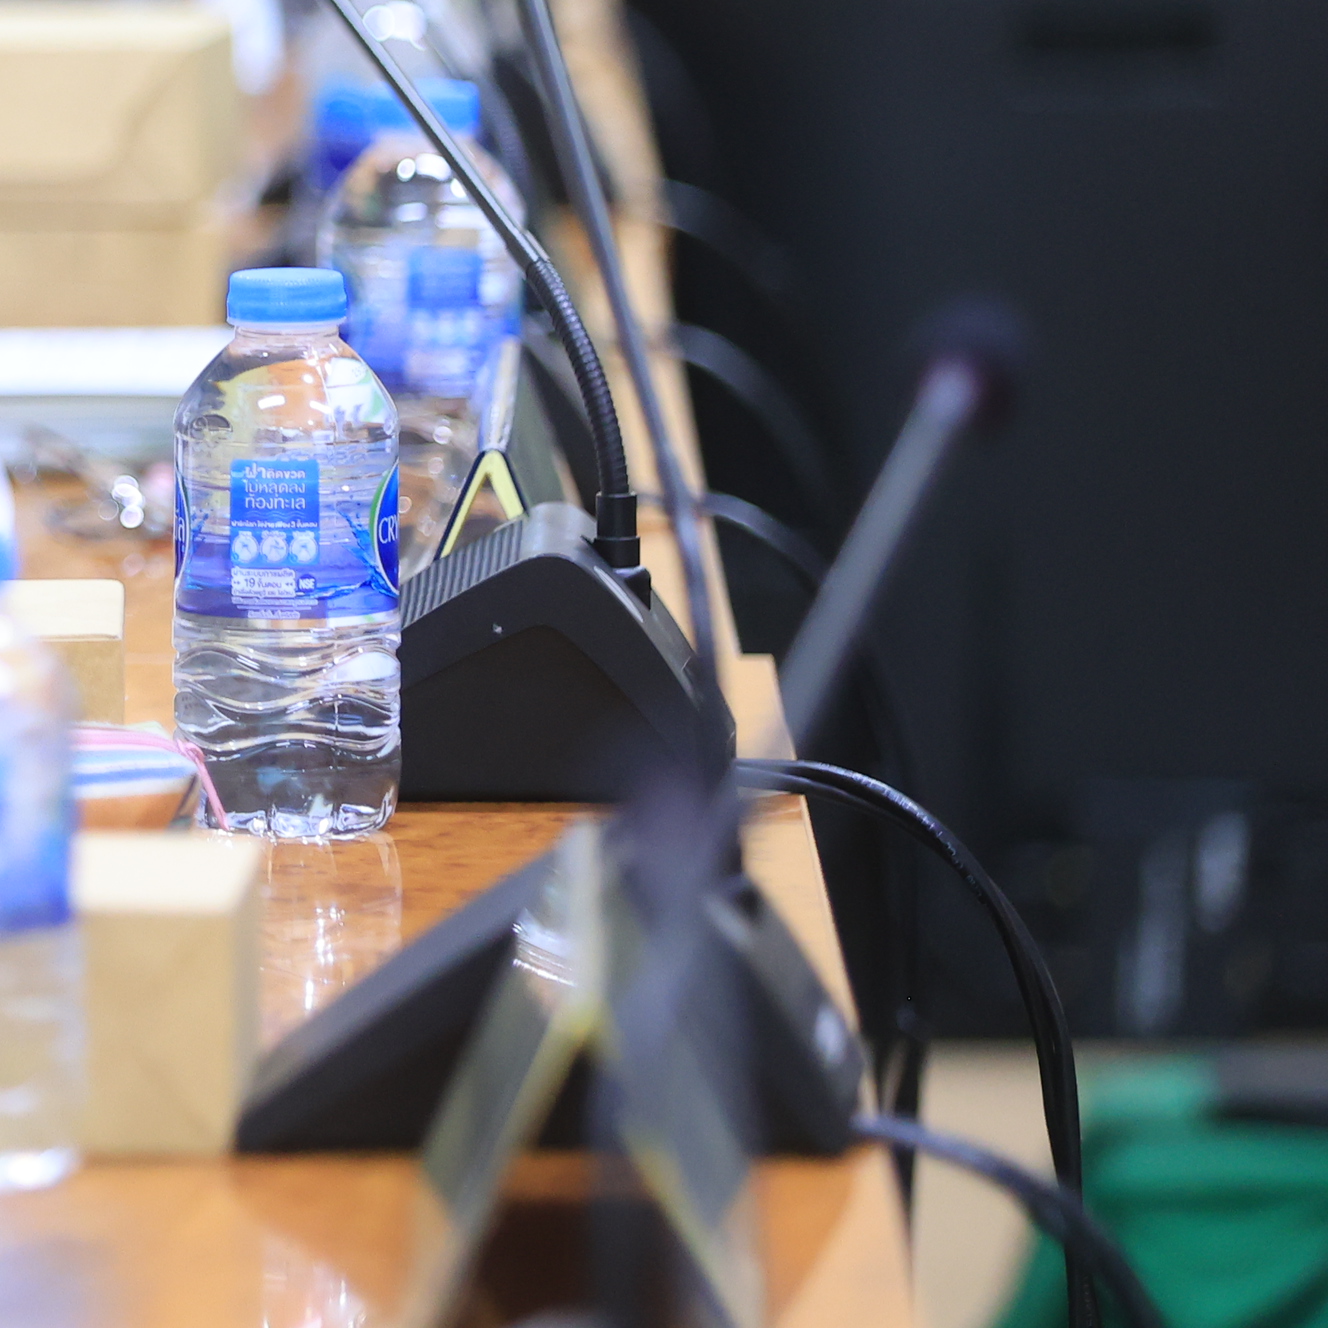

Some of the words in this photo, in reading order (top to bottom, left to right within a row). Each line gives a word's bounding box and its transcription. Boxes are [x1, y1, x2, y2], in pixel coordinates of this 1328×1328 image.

[242, 479, 306, 497] ไม่หลุดลง
[245, 494, 306, 510] ท้องทะเล
[244, 577, 256, 588] 19
